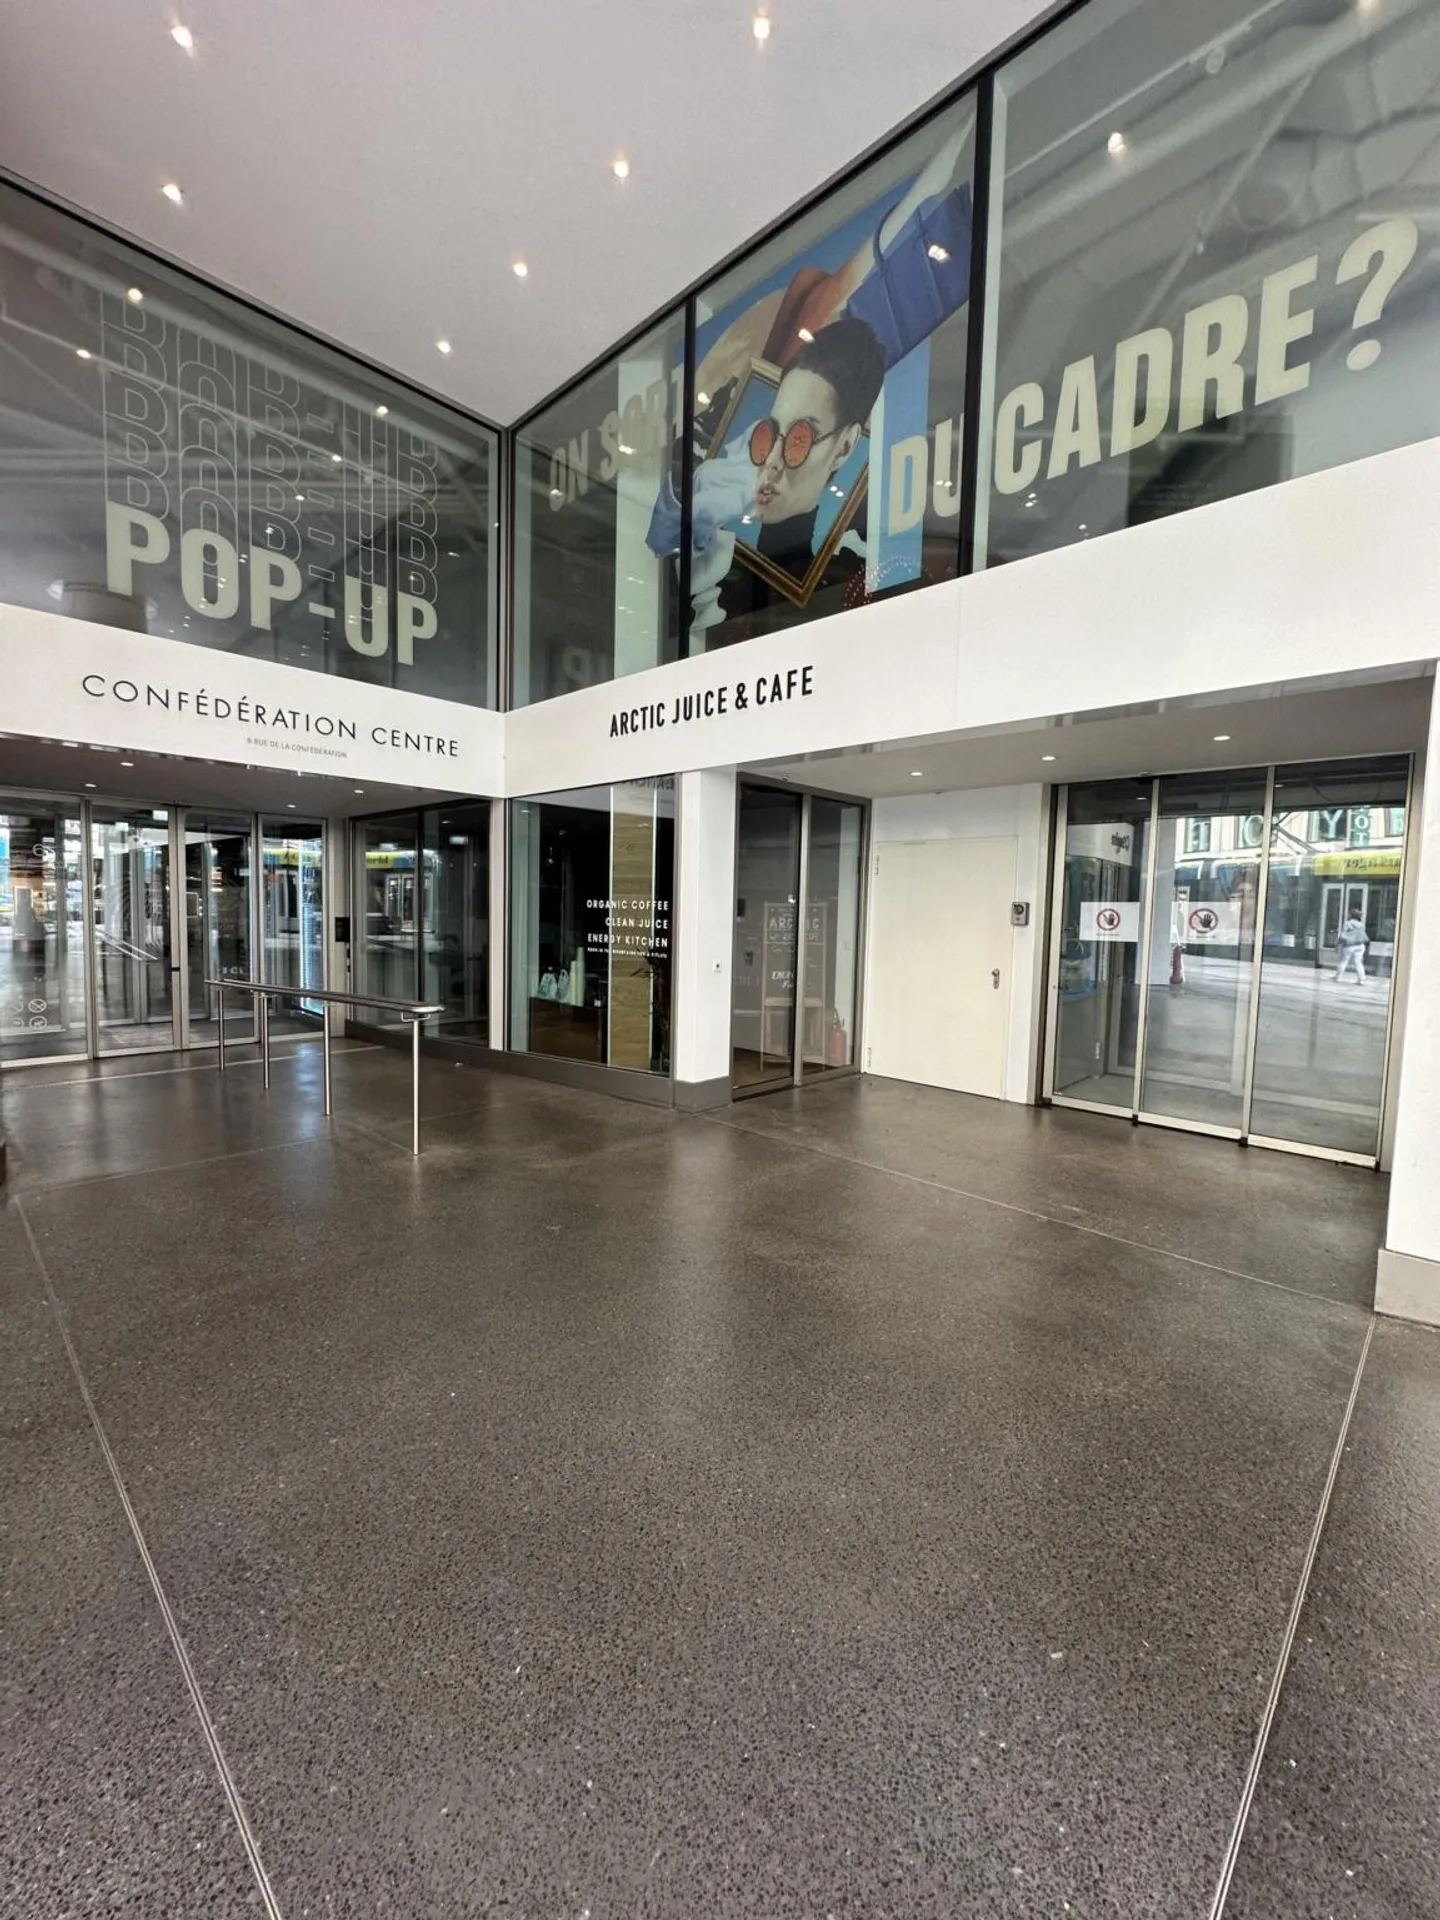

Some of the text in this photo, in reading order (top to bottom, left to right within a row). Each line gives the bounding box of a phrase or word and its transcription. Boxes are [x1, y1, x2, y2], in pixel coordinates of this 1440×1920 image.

[549, 429, 588, 512] ON
[888, 413, 964, 537] DU
[105, 500, 438, 666] POP-UP
[610, 665, 813, 738] ARCTIC JUICE & CAFE
[82, 674, 459, 757] CONFÉDÉRATION CENTRE
[254, 738, 267, 746] RUE
[270, 741, 279, 749] DE
[281, 742, 290, 750] LA
[586, 899, 669, 911] ORGANIC COFFEE
[605, 917, 634, 927] CLEAN
[769, 917, 820, 930] ARCIC
[625, 935, 668, 948] KITCHEN
